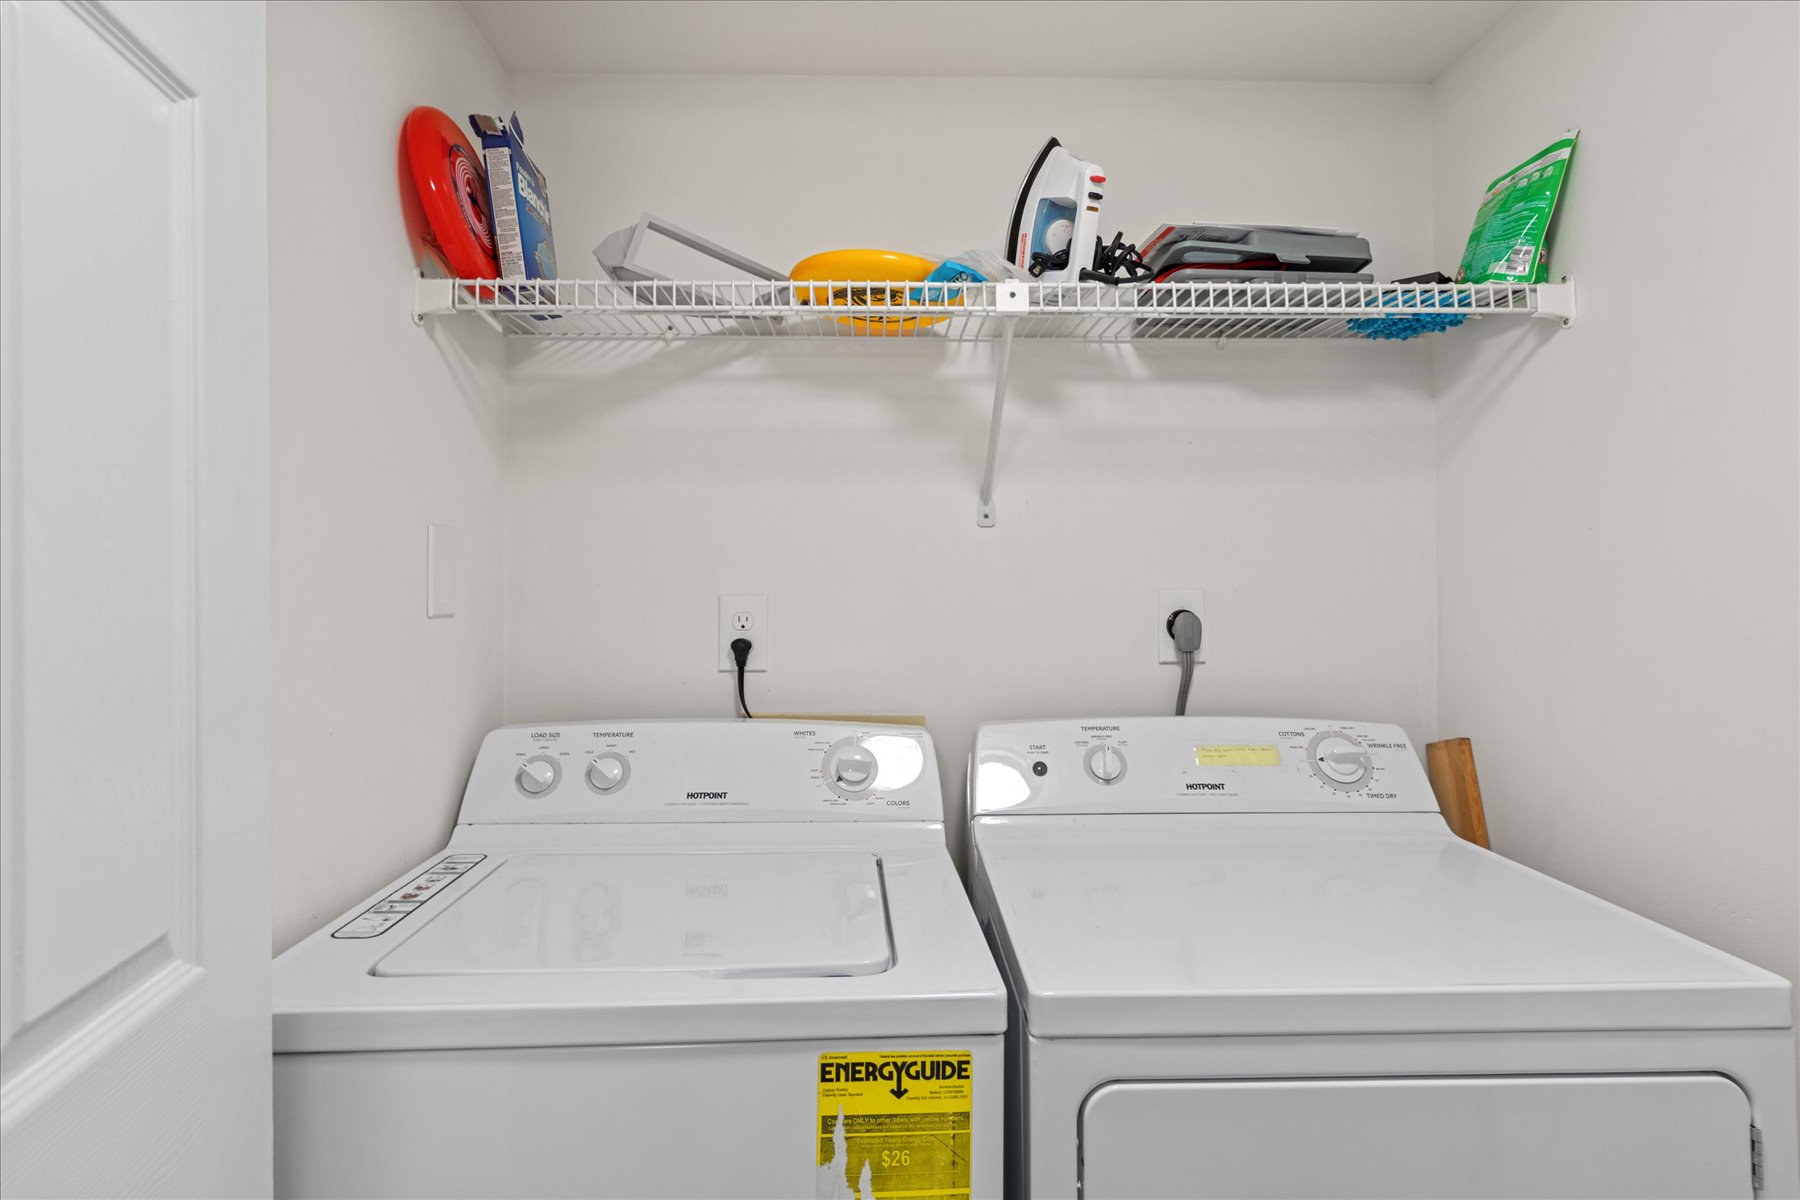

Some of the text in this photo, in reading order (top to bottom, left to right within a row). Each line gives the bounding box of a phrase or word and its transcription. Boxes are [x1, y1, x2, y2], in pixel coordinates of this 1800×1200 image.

[686, 791, 728, 799] HOTPOINT
[820, 1060, 970, 1082] ENERGYGUIDE
[827, 1117, 852, 1125] Coare
[902, 1136, 922, 1144] Energy
[881, 1150, 910, 1168] $26
